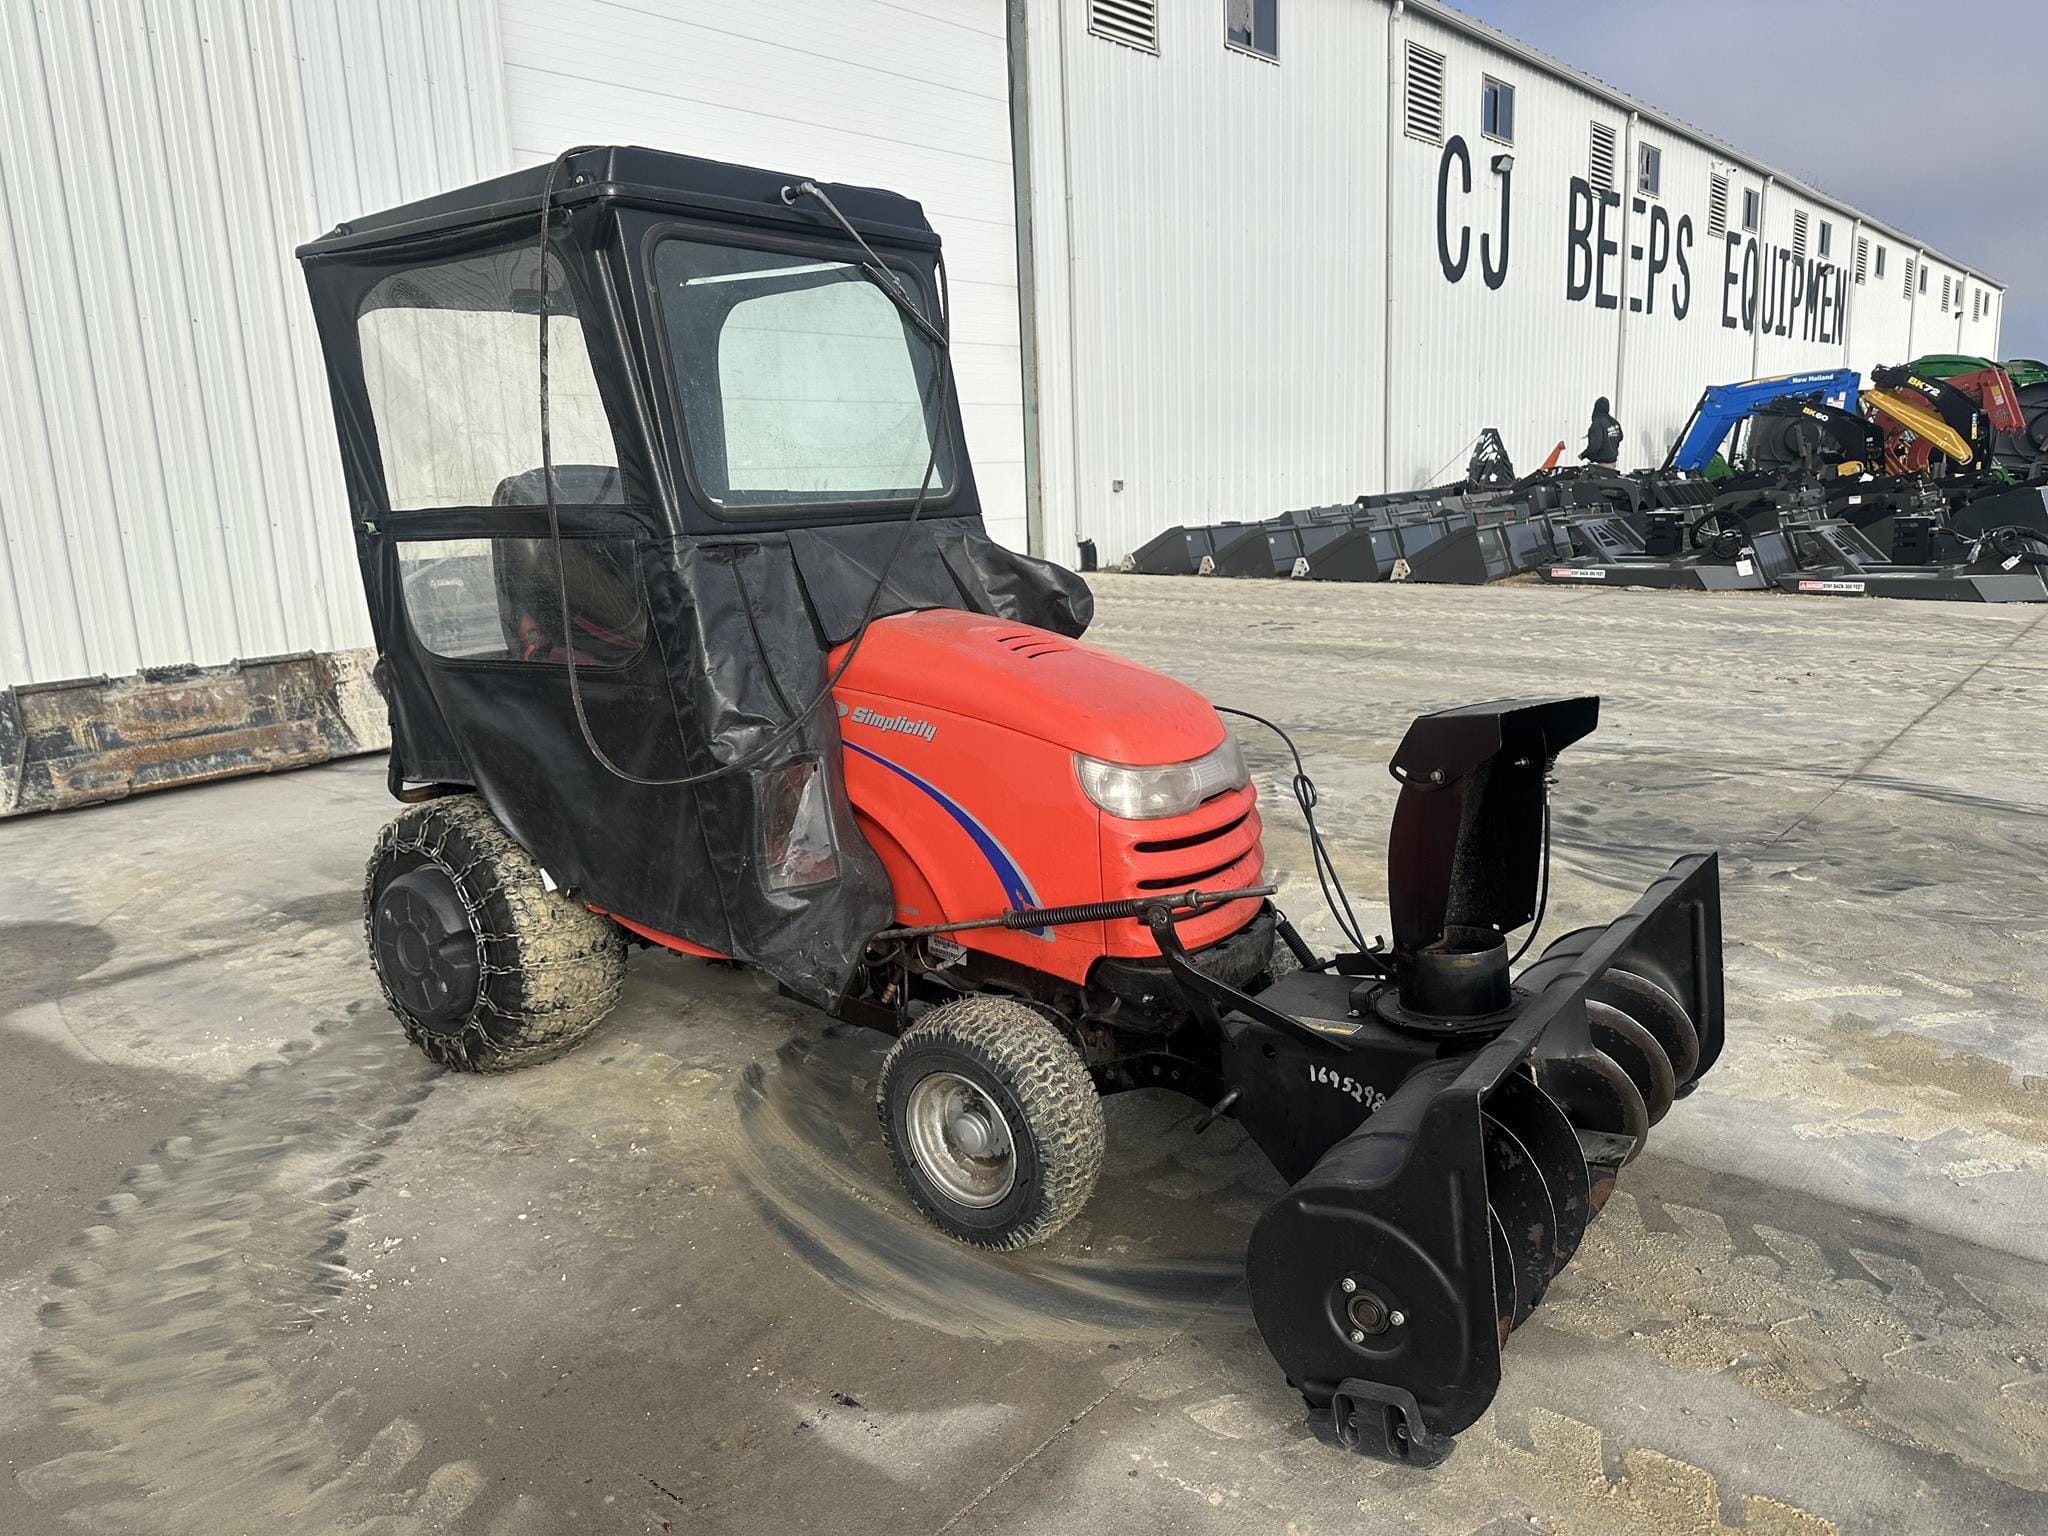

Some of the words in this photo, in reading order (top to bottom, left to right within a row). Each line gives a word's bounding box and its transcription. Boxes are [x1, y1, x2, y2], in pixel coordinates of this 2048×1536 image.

[1437, 135, 1511, 290] CJ
[1722, 231, 1860, 346] EQUIPMEN
[1808, 373, 1834, 381] Holland
[1907, 376, 1941, 397] BK72
[1802, 406, 1829, 421] BK60
[850, 706, 938, 742] Simplicity
[1309, 1064, 1387, 1113] 1695298
